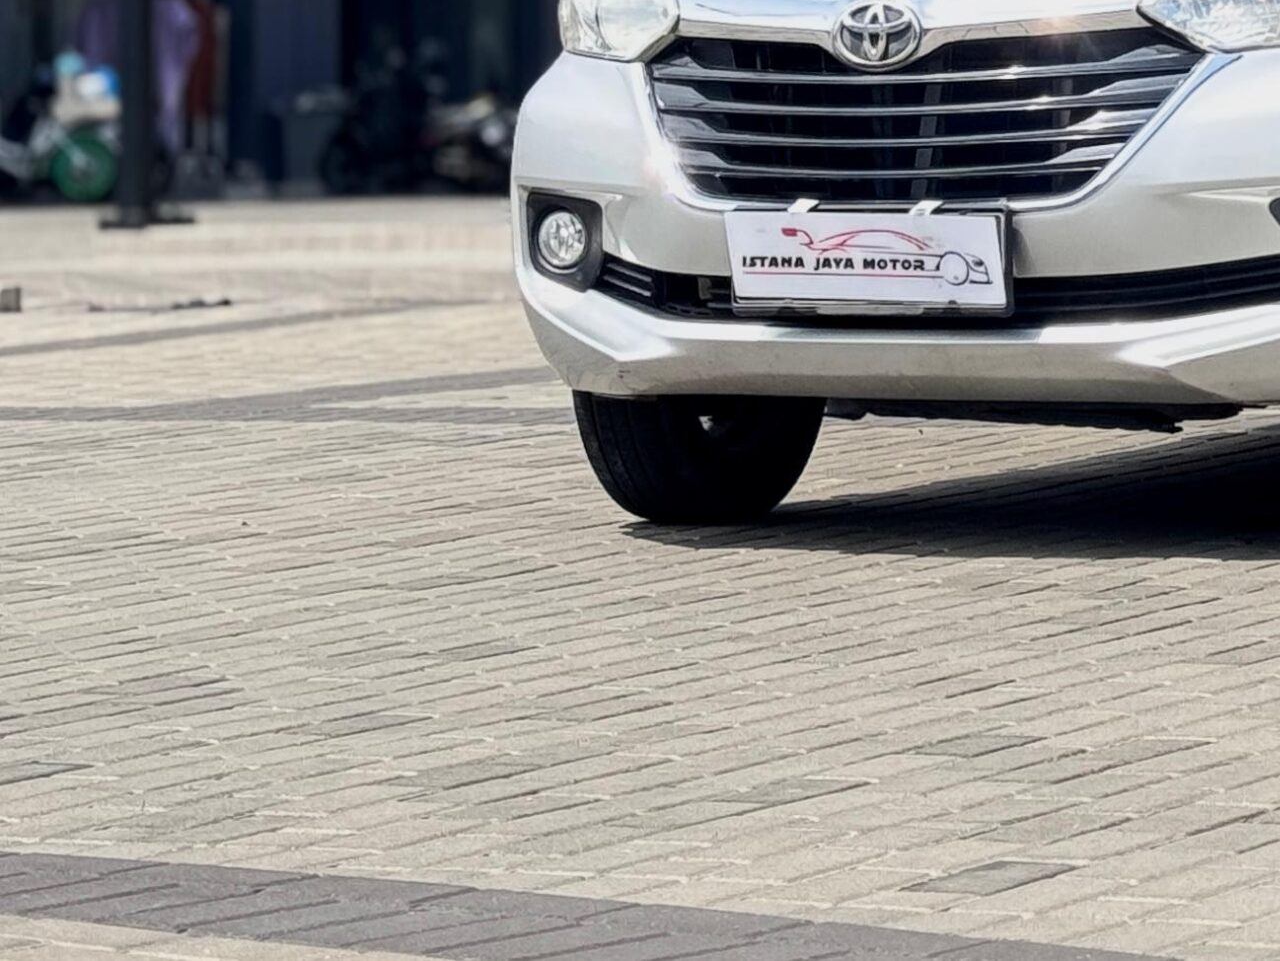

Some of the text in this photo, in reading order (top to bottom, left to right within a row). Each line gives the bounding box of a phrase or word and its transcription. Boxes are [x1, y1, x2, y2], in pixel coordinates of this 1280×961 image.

[742, 255, 926, 272] ISTANA JAYA MOTOR
